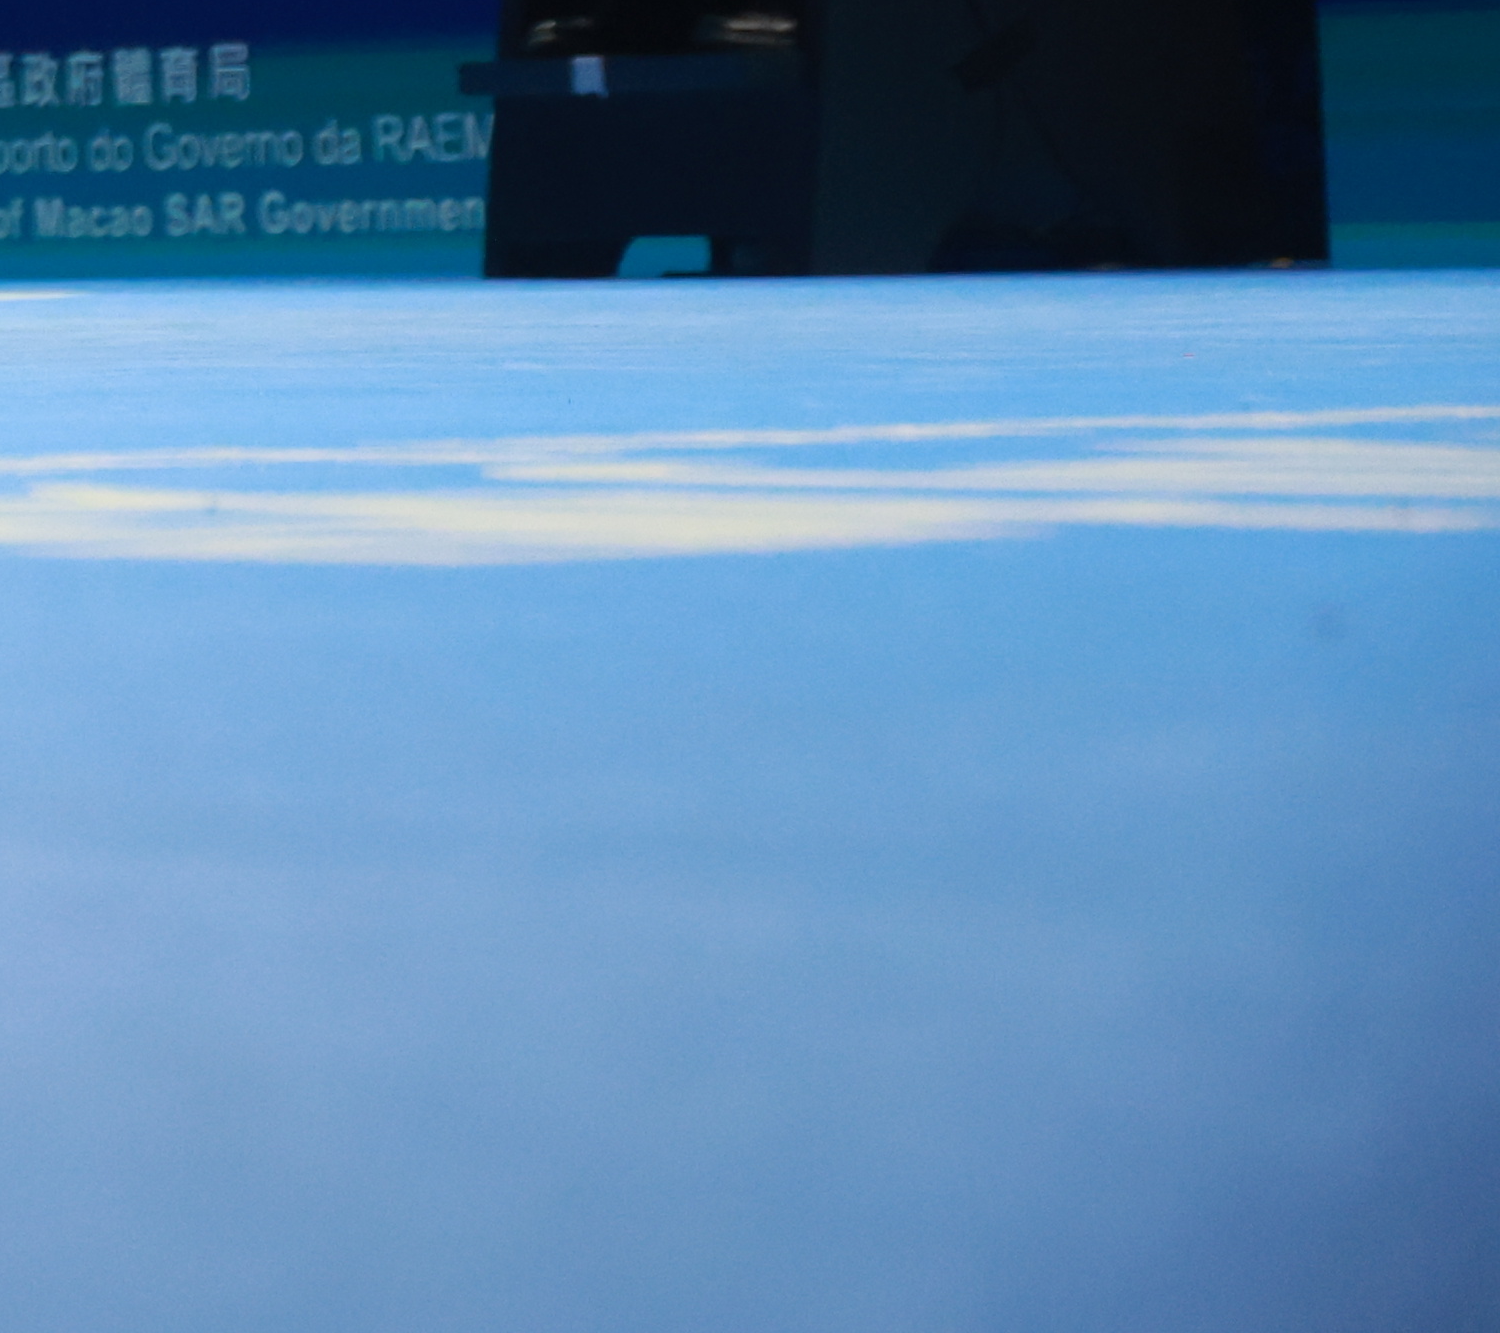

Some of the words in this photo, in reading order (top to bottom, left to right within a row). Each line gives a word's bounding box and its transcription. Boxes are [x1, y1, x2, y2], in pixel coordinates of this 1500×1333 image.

[88, 128, 135, 173] do
[143, 121, 304, 172] Governo
[312, 118, 362, 165] da
[34, 196, 154, 239] Macao
[164, 190, 247, 237] SAR
[258, 189, 485, 235] Governmen
